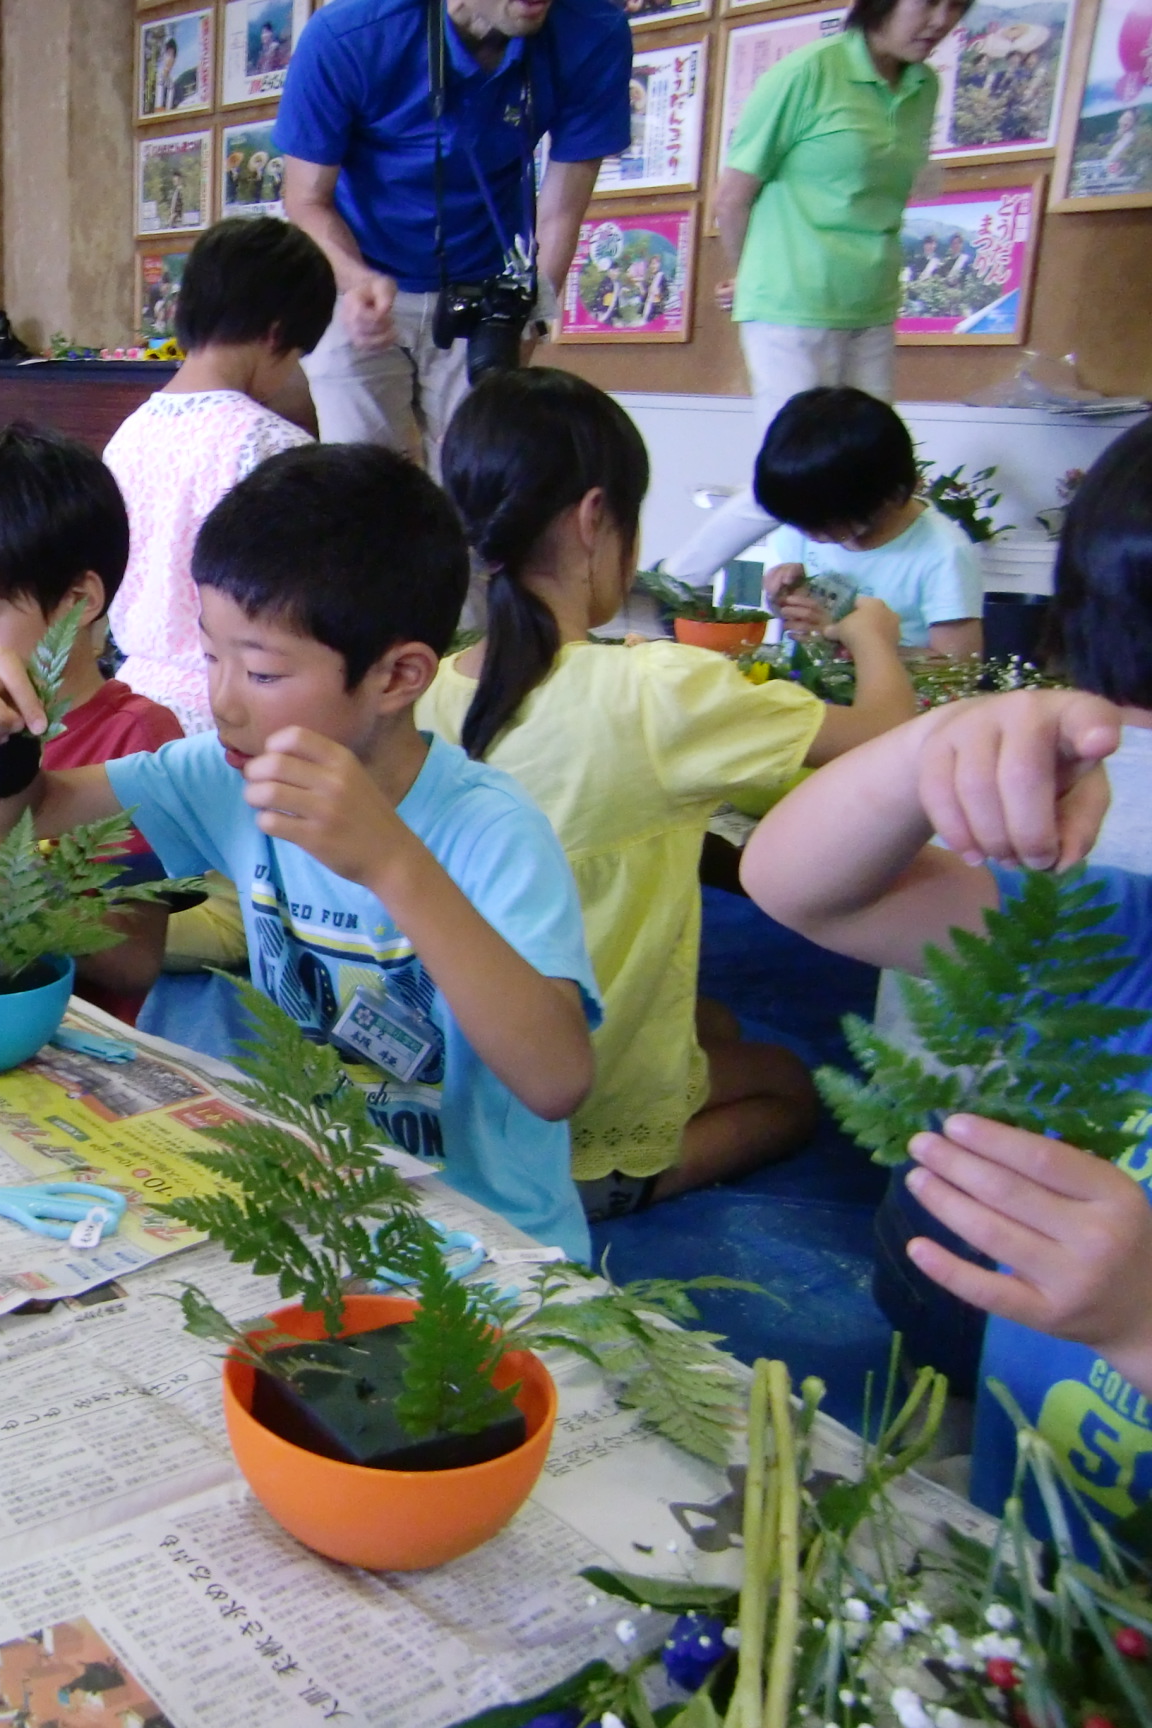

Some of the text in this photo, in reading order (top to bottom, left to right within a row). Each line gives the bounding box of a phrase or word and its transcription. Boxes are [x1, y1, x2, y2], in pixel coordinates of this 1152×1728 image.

[970, 213, 994, 279] まつり
[983, 193, 1018, 285] どうだん
[322, 908, 359, 929] FUN
